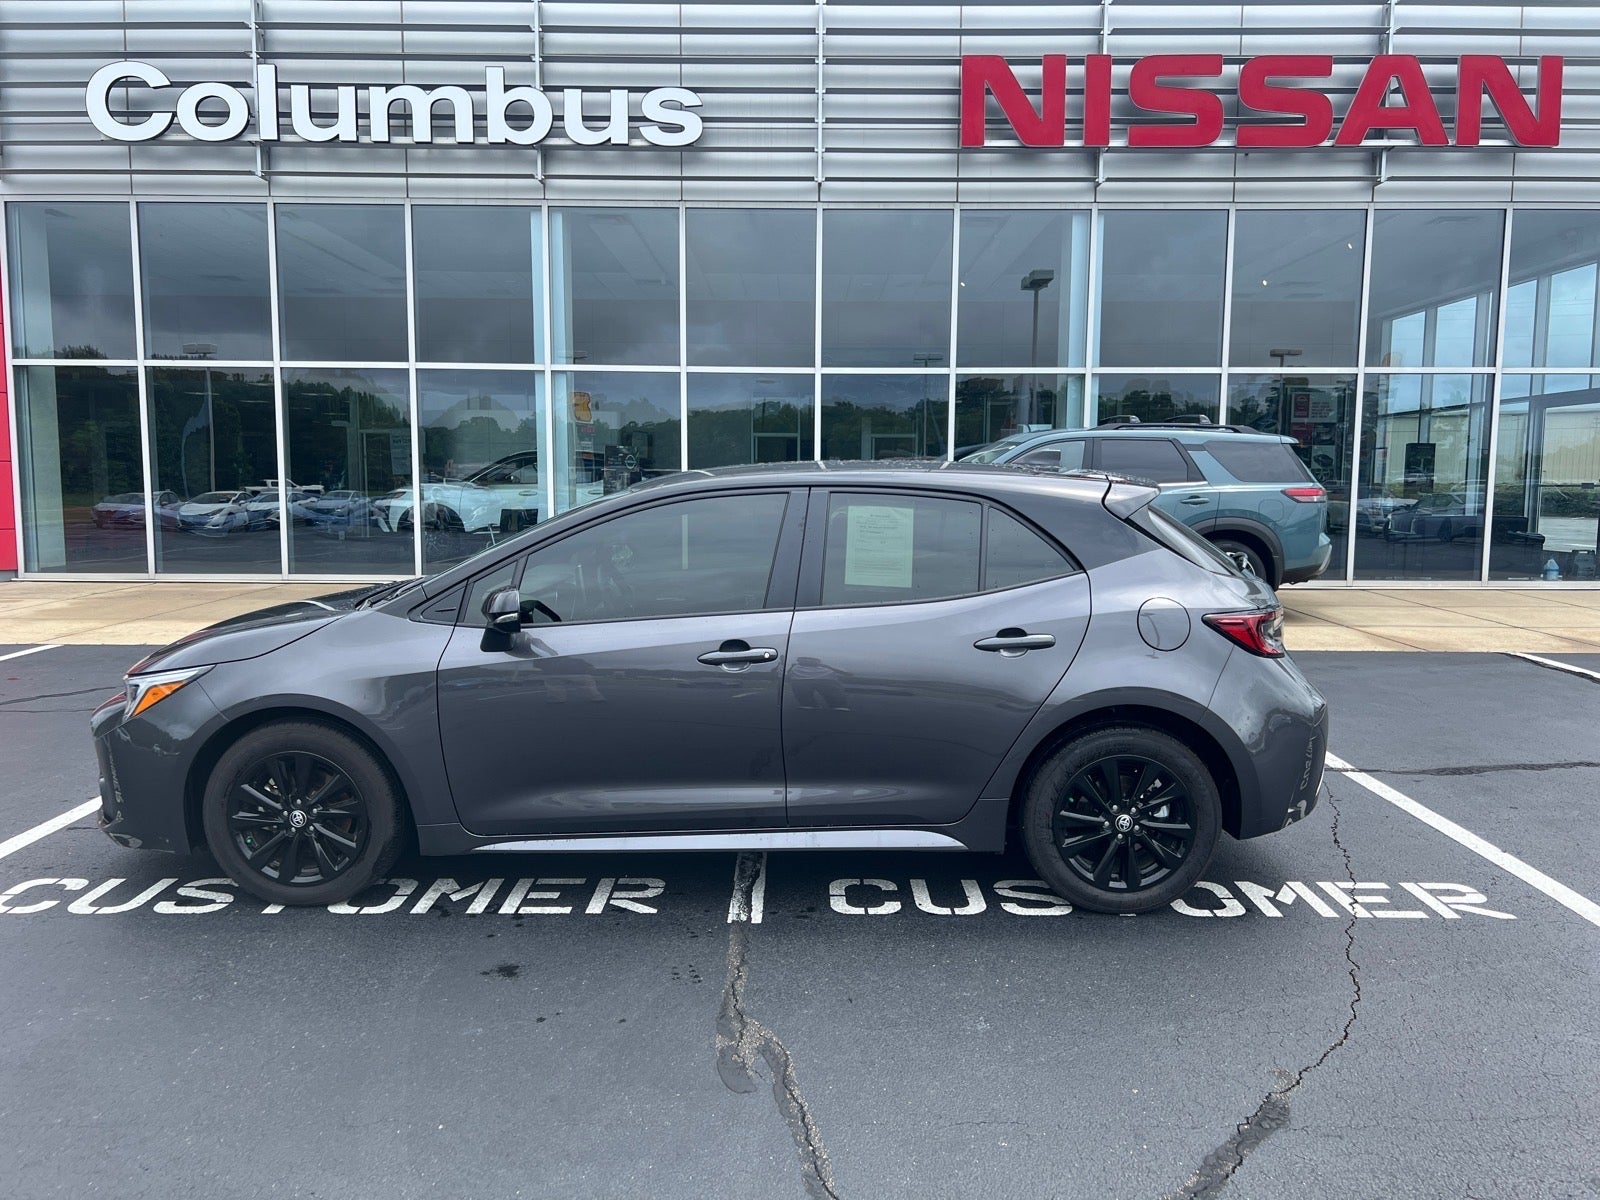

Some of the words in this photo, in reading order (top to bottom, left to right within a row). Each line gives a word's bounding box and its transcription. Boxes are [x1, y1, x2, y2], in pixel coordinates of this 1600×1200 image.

[85, 60, 704, 147] Columbus
[960, 54, 1564, 148] NISSAN
[0, 878, 666, 914] CUSOMER
[829, 878, 1518, 919] CUSOMER
